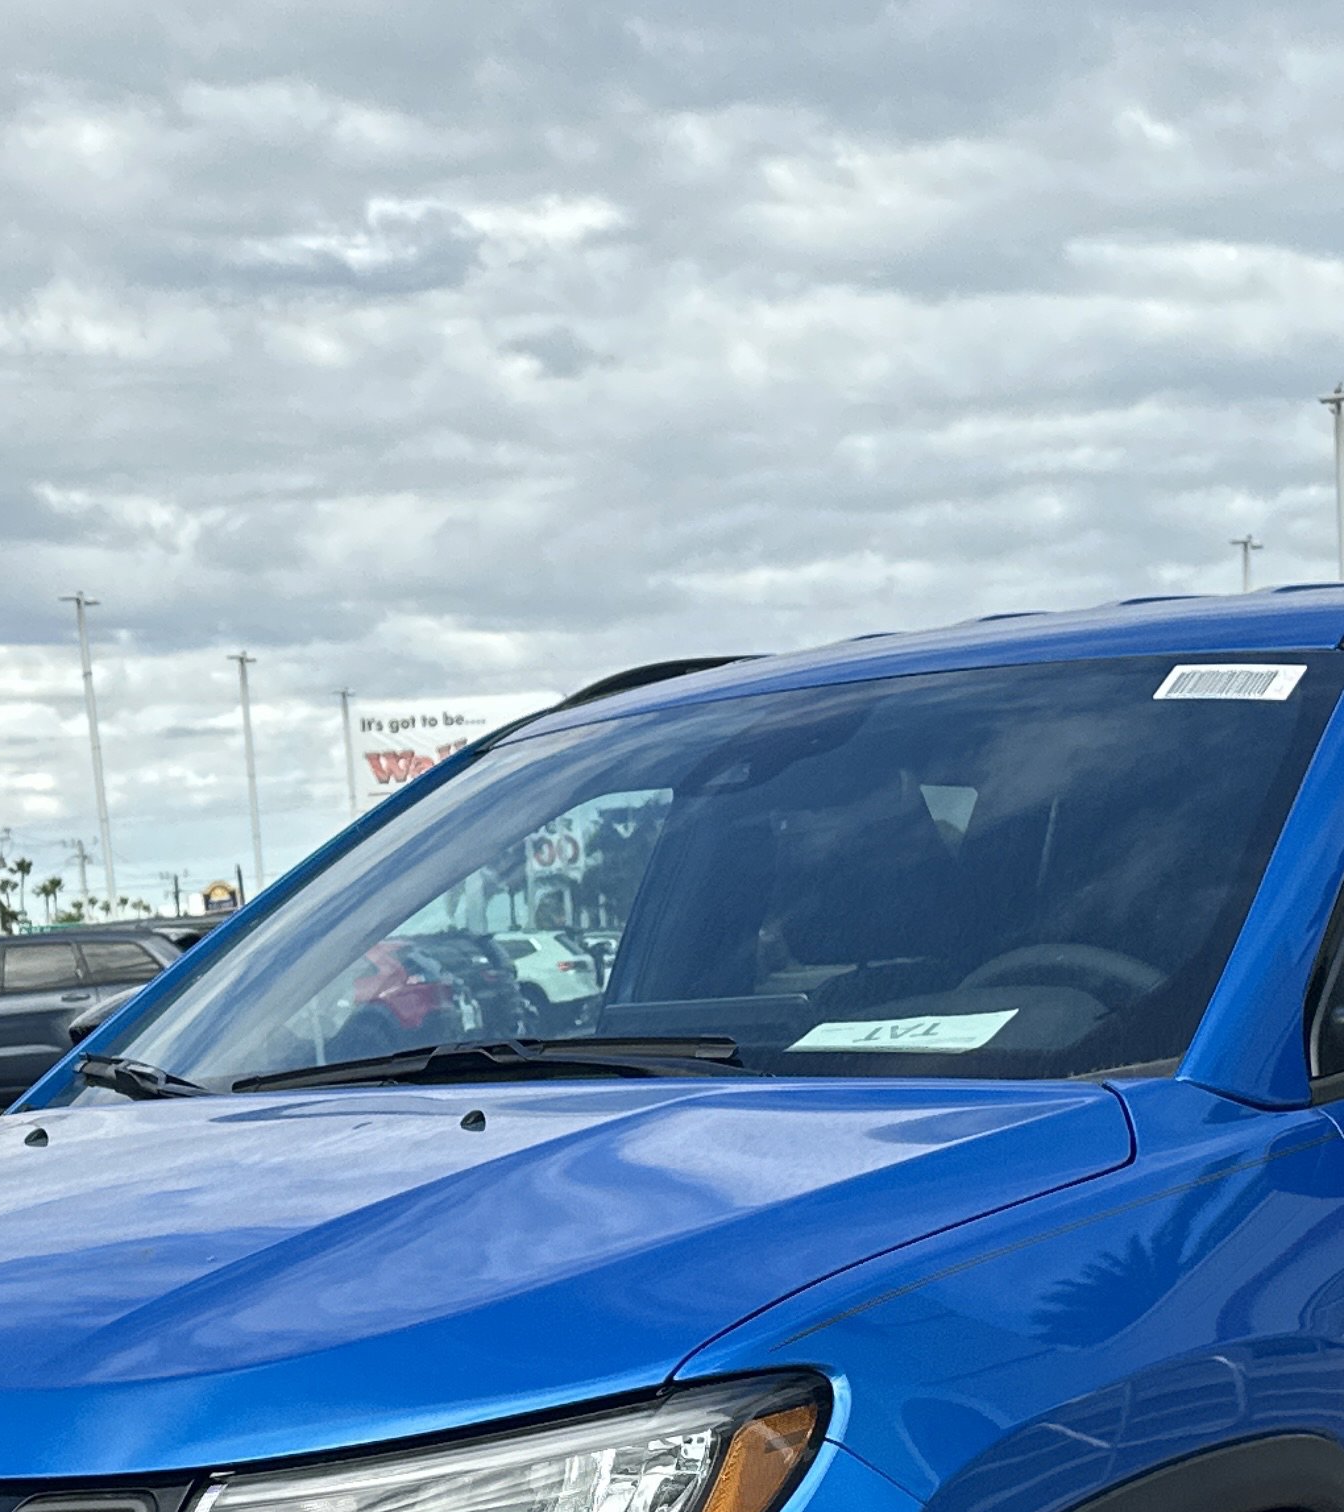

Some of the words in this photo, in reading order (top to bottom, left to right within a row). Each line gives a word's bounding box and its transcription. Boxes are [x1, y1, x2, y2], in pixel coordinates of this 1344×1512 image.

[360, 716, 384, 732] It's
[388, 715, 415, 733] got
[421, 714, 438, 728] to
